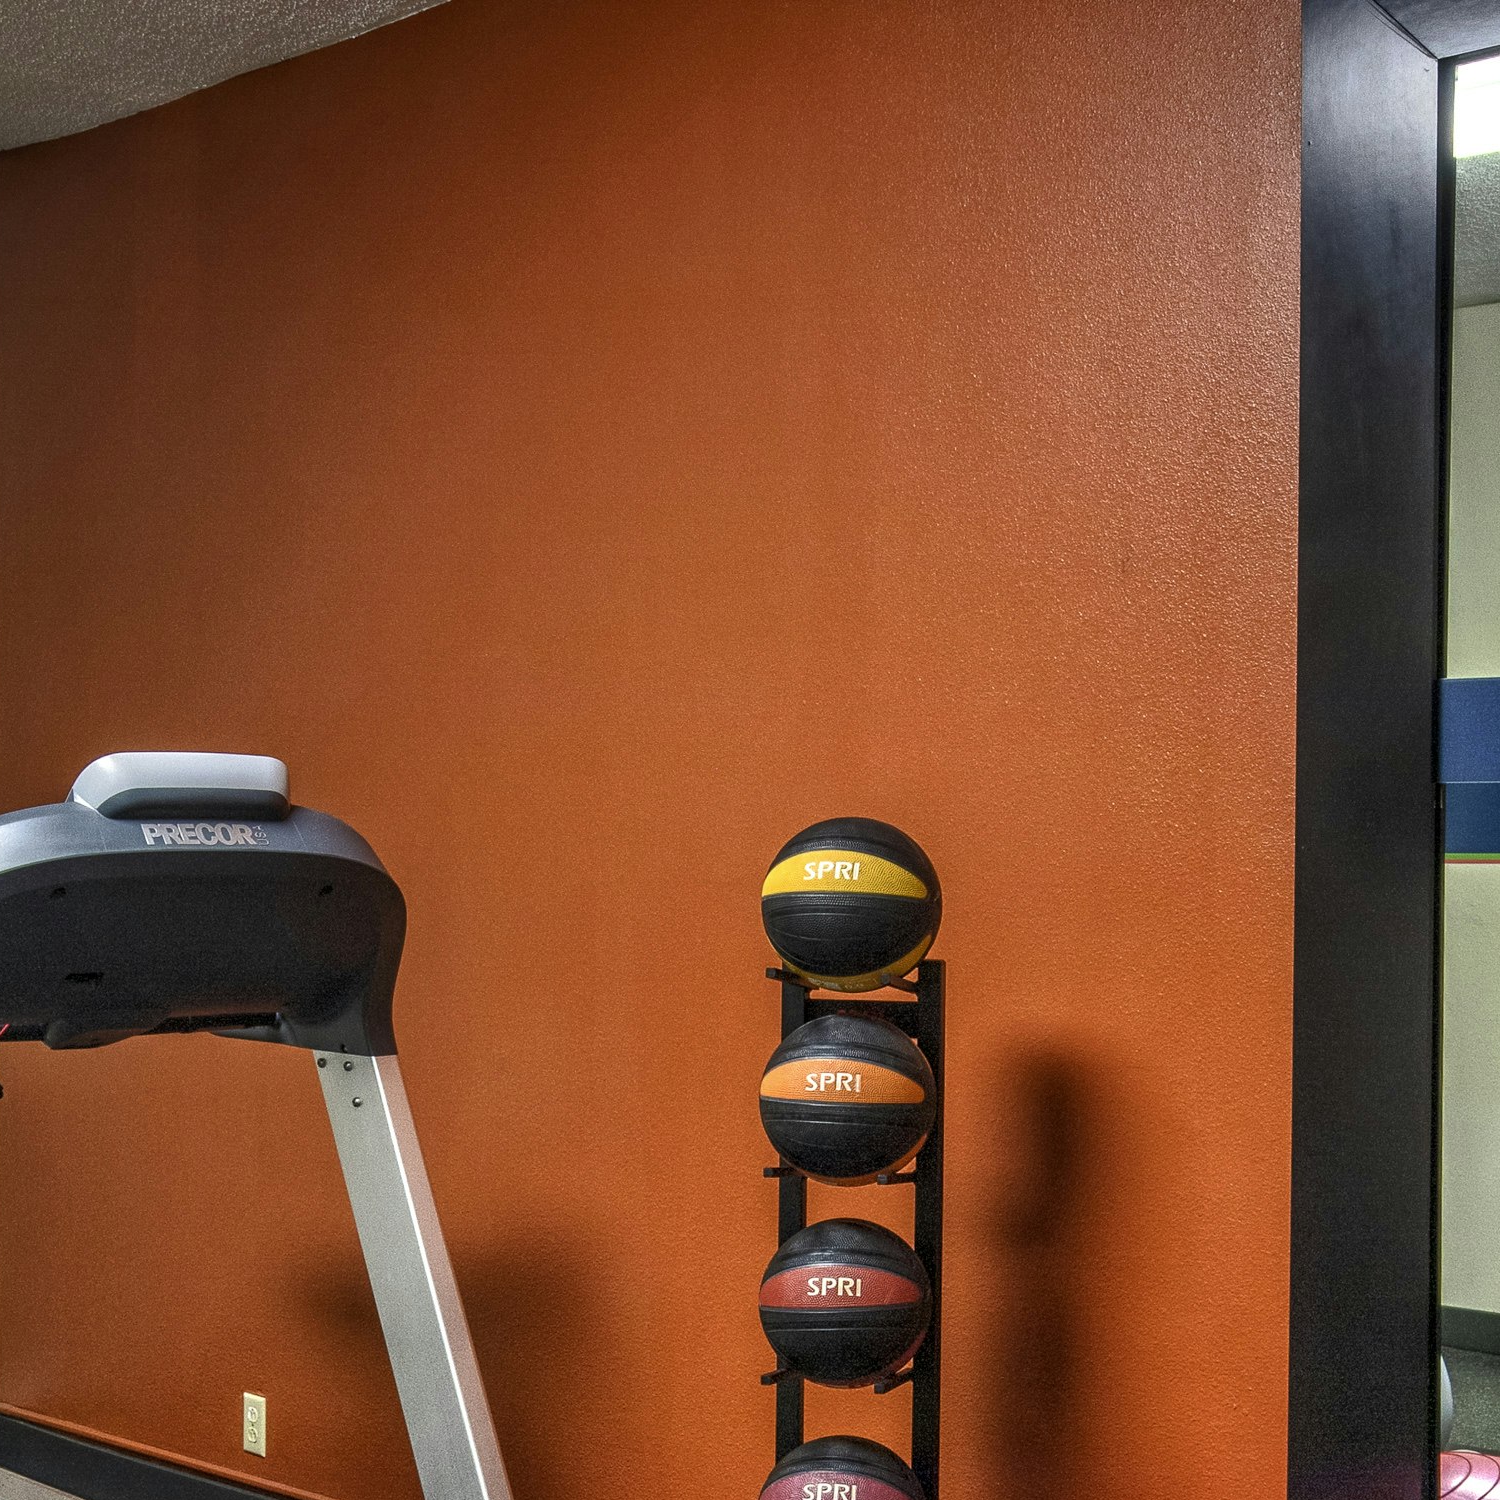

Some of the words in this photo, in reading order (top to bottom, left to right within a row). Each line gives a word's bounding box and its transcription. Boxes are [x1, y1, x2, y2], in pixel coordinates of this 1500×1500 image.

[140, 823, 257, 845] PRECOR
[803, 861, 860, 881] SPRI
[805, 1072, 861, 1093] SPRI
[807, 1277, 862, 1297] SPRI
